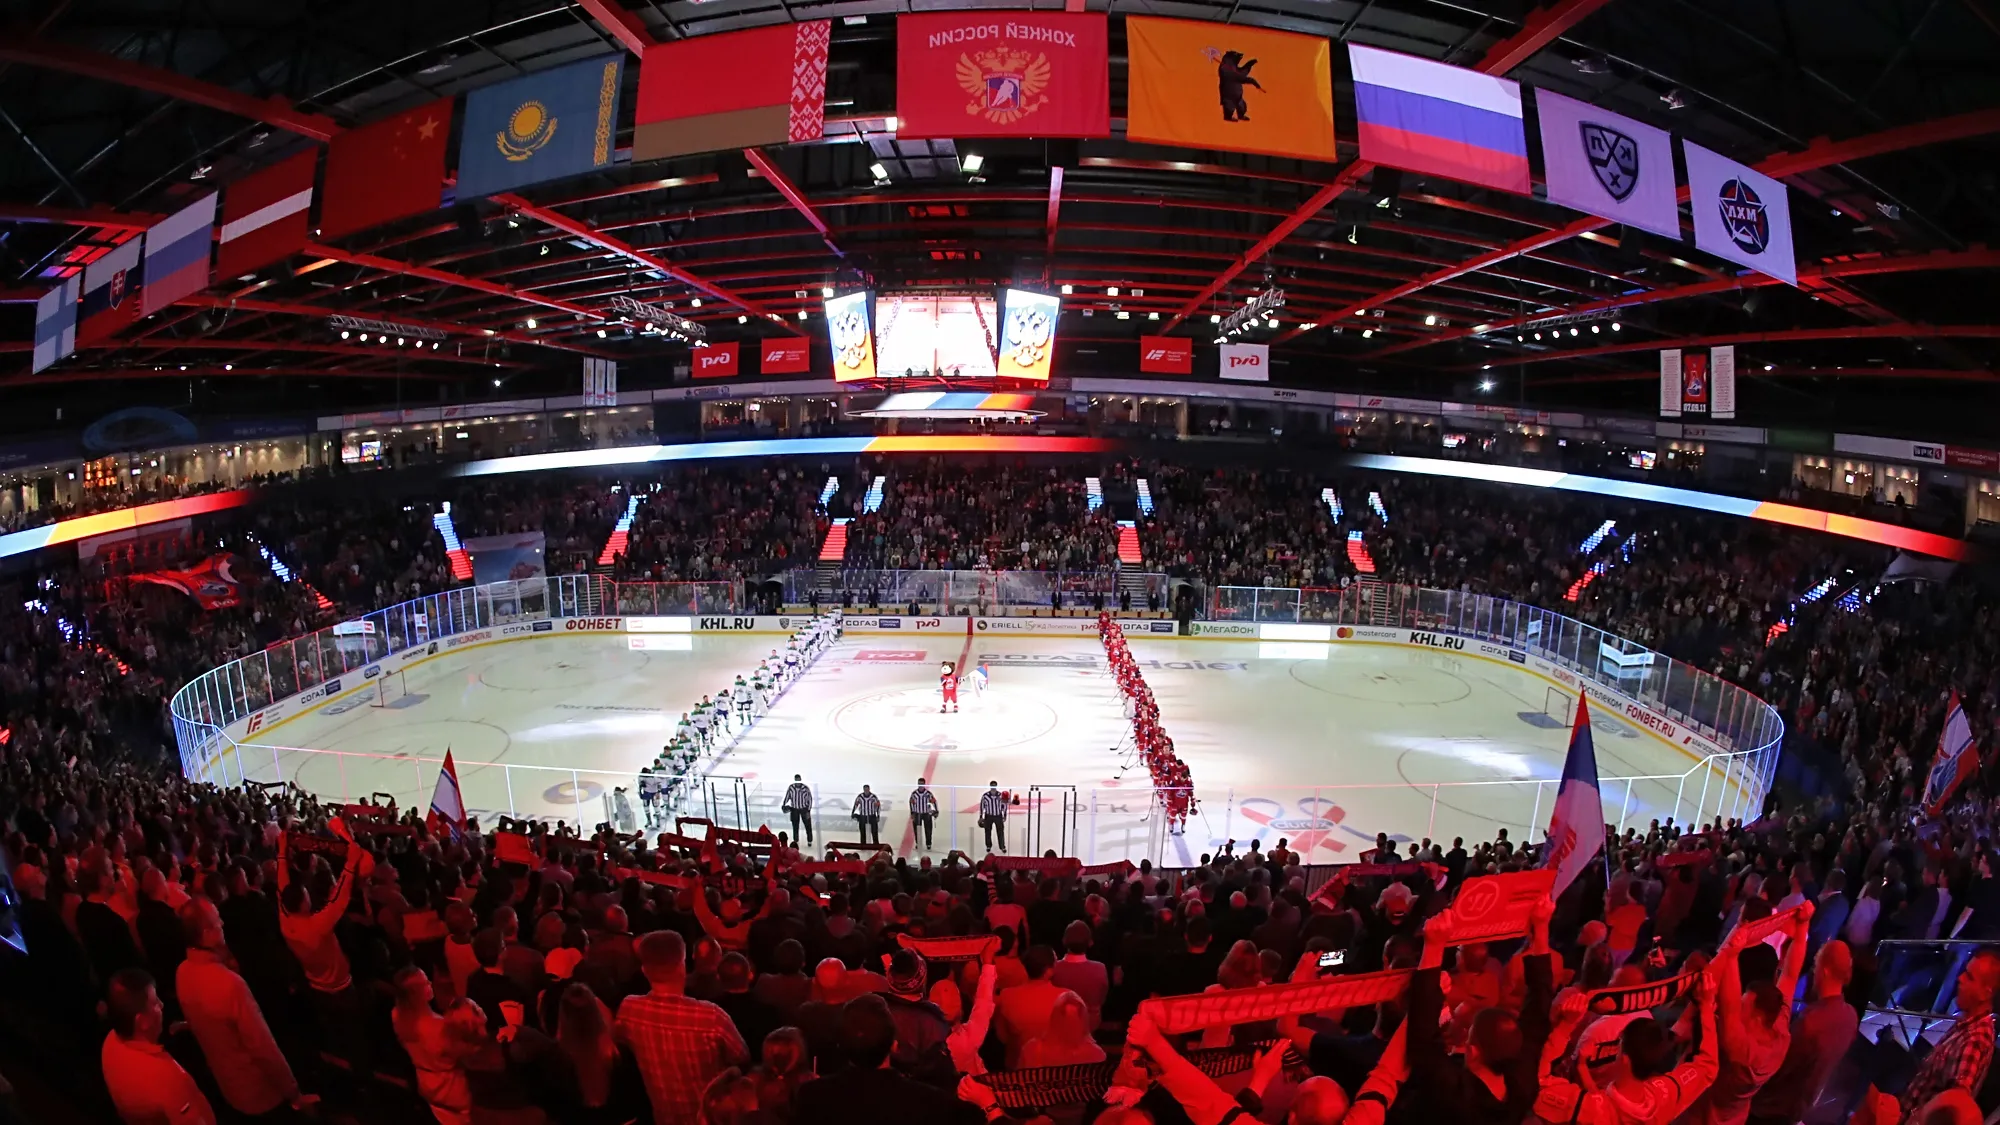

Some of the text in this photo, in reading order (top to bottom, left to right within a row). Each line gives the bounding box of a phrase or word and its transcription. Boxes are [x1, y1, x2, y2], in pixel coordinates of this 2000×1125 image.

[1683, 403, 1707, 412] 07.09.11
[502, 624, 531, 635] СОГАЗ
[565, 618, 622, 630] ФОНБЕТ
[700, 617, 755, 630] KHL.RU
[1356, 629, 1397, 639] mastercard
[1409, 631, 1465, 650] KHL.RU
[1480, 645, 1508, 657] СОГАЗ
[300, 689, 325, 705] СОГАЗ
[1625, 704, 1676, 738] FONBET.RU
